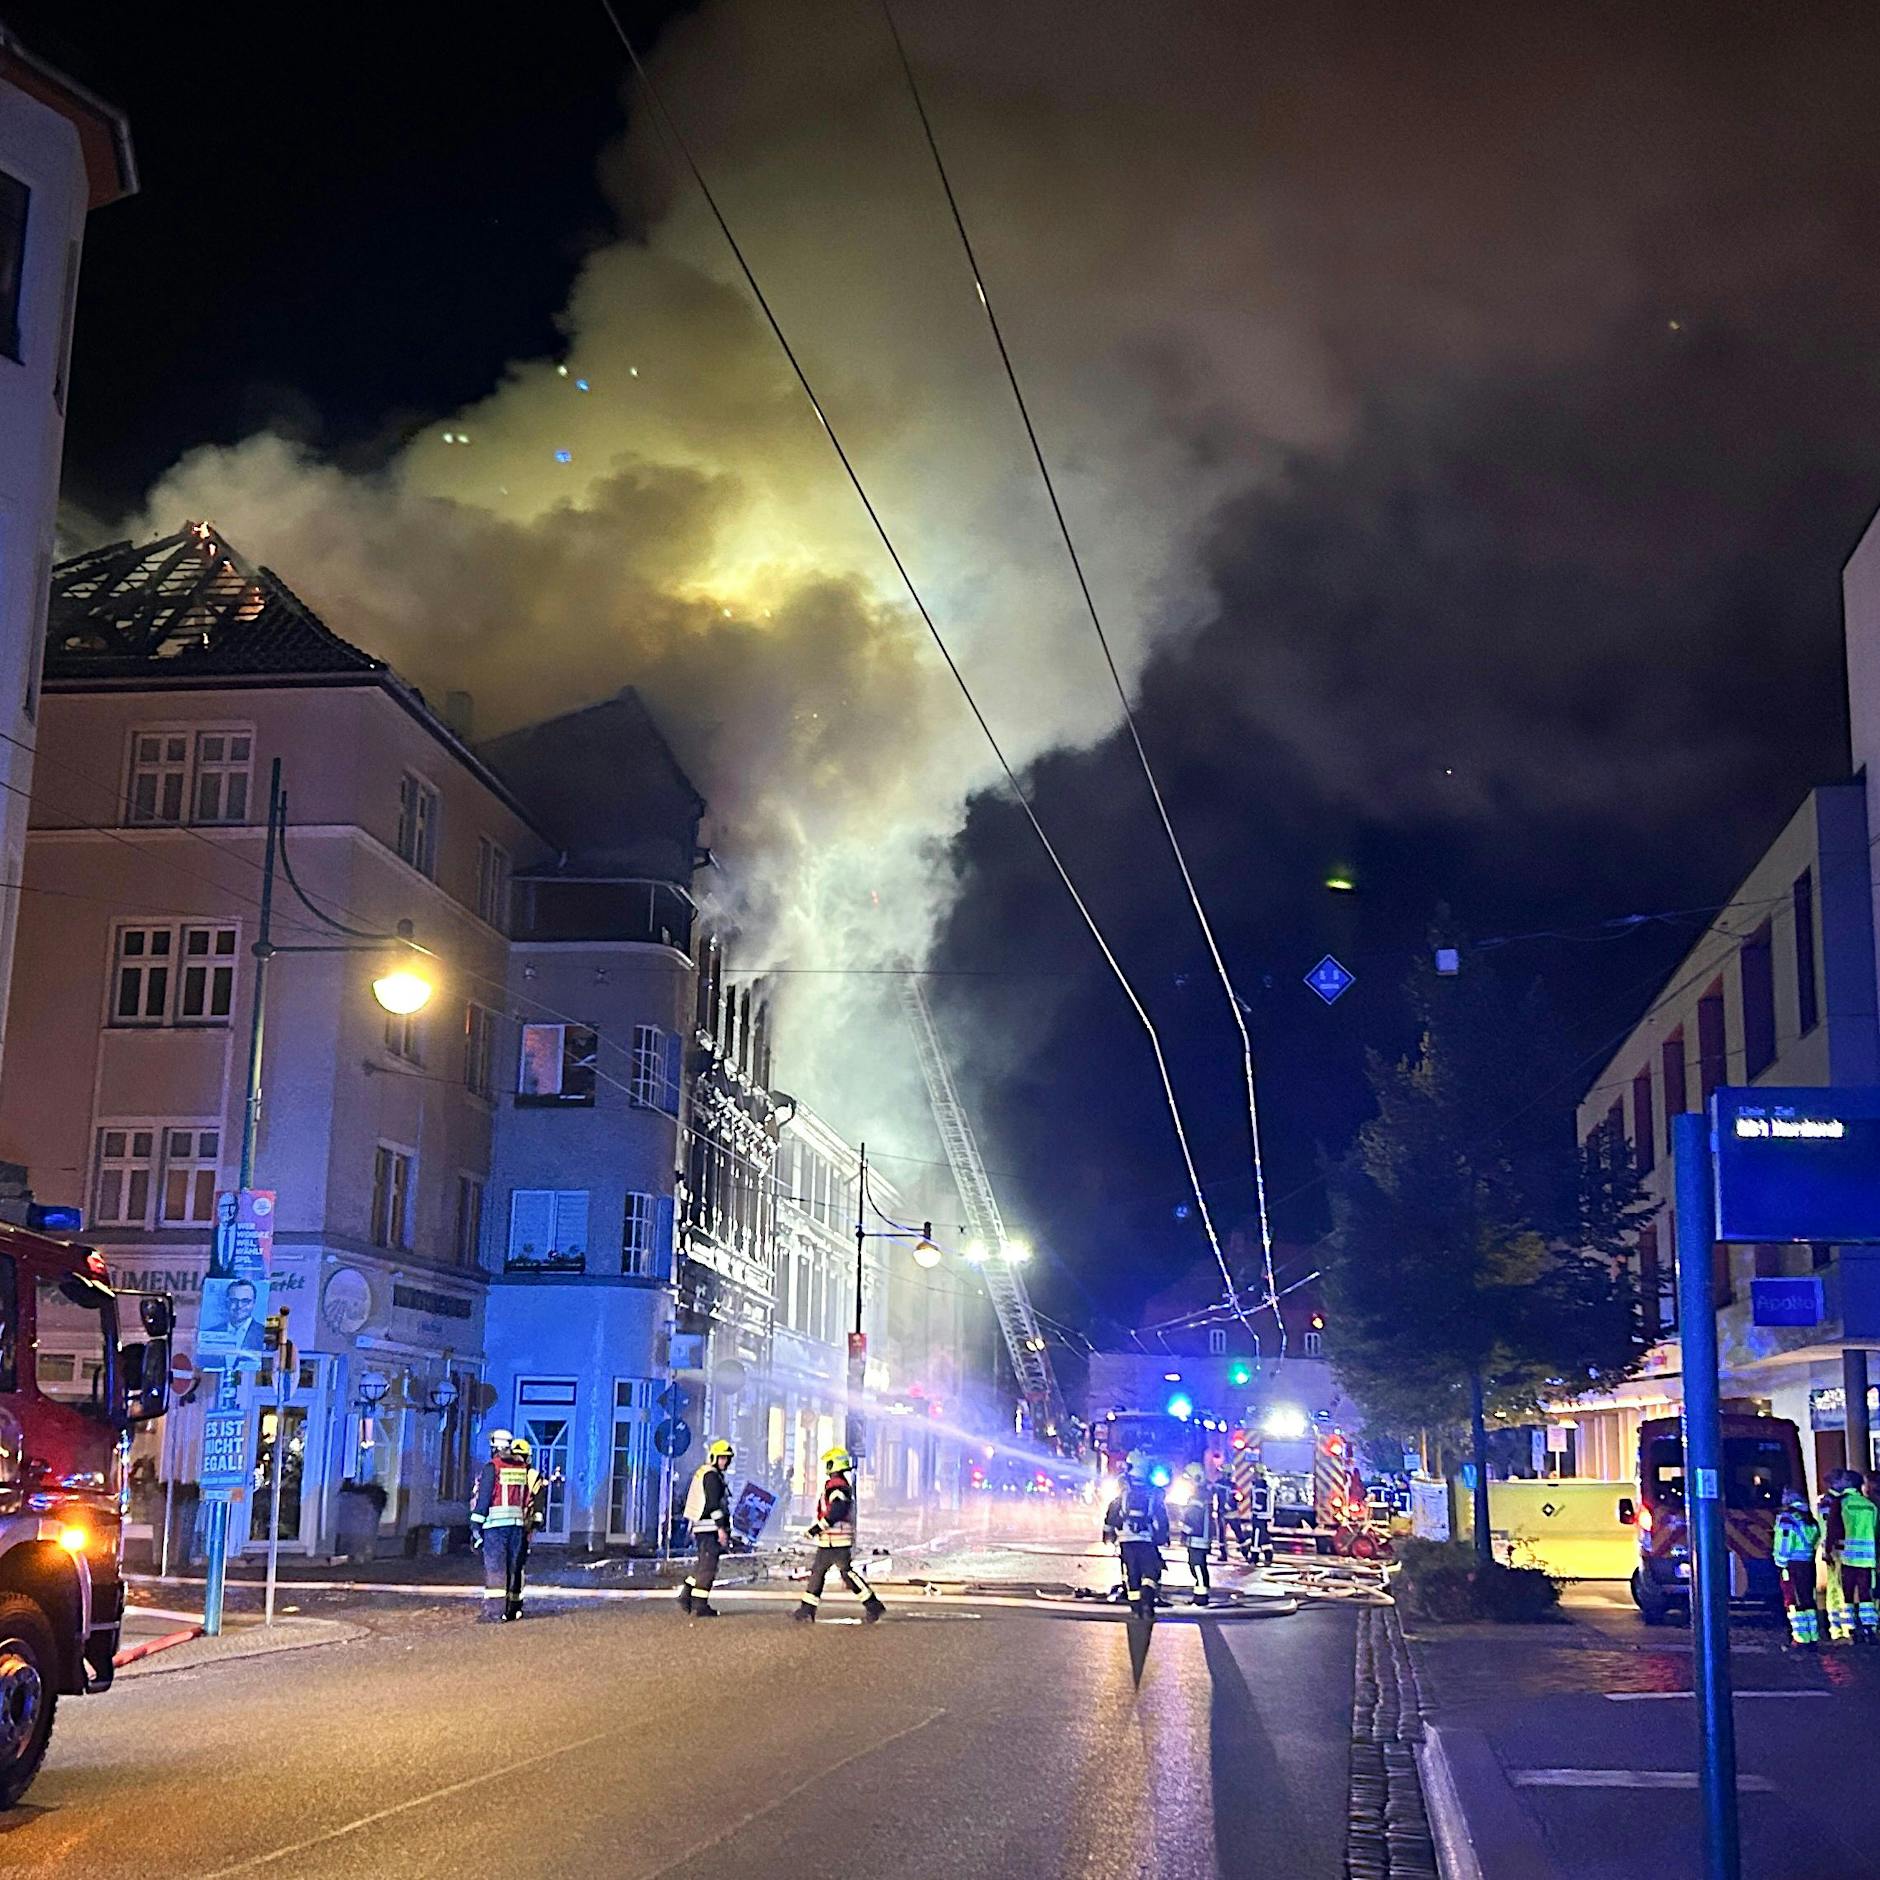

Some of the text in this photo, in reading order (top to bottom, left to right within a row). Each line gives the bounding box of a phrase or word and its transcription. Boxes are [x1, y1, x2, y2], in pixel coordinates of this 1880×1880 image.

[206, 1420, 244, 1437] ES IST
[204, 1454, 244, 1472] EGAL!
